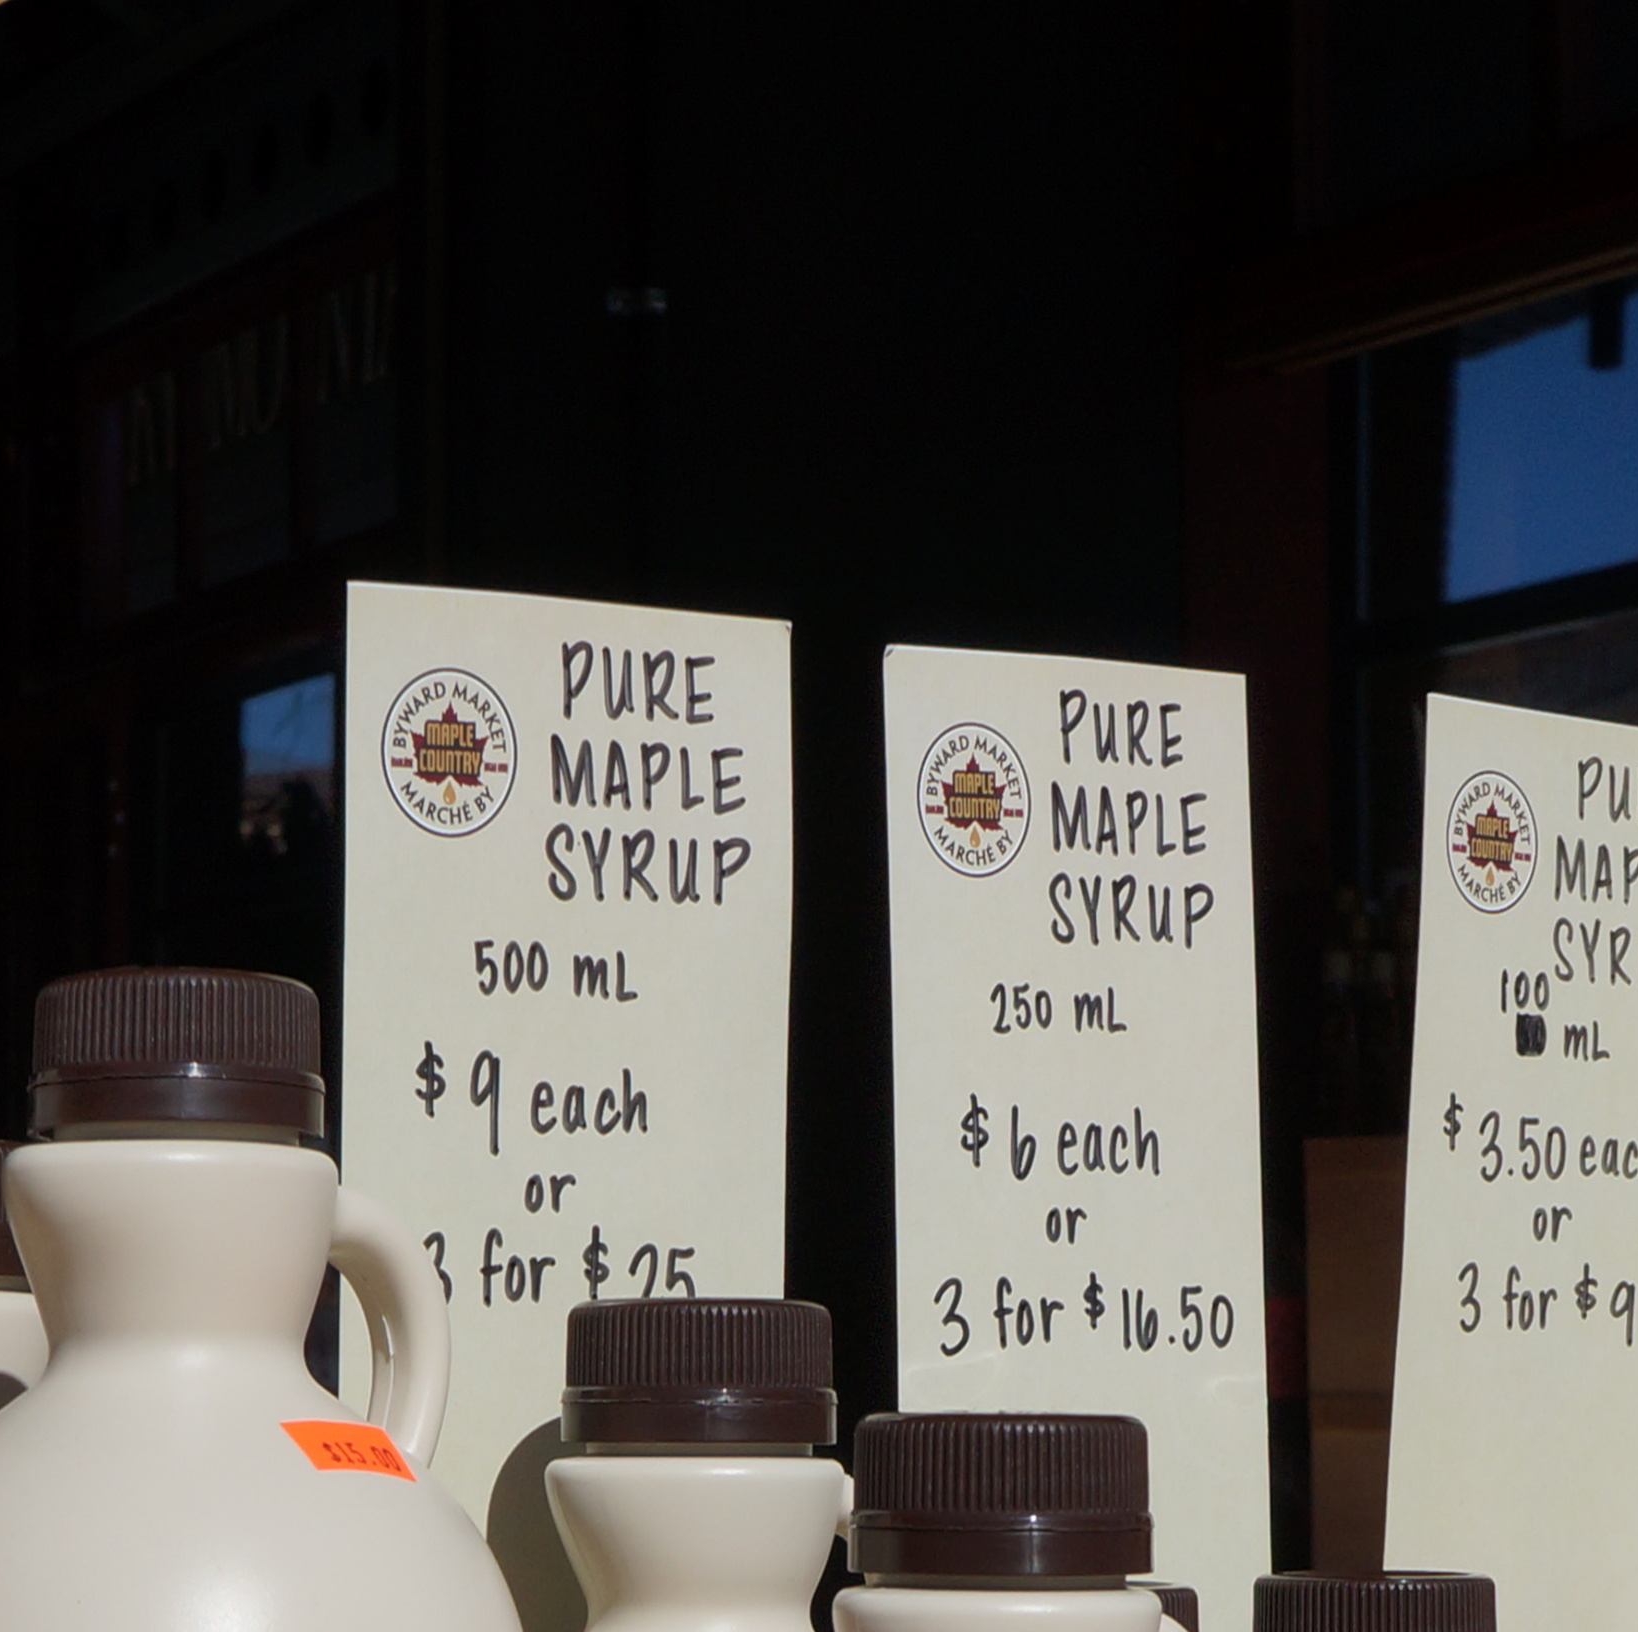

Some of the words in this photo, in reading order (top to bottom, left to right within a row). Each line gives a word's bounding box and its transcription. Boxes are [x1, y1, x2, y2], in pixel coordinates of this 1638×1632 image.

[560, 641, 716, 725] PURE
[393, 681, 445, 749] BYWARD
[452, 681, 506, 753] MARKET
[426, 722, 474, 747] MAPLE
[1058, 687, 1185, 771] PURE
[419, 747, 481, 774] COUNTRY
[550, 733, 747, 814] MAPLE
[926, 735, 969, 796] BYWARD
[974, 735, 1022, 800] MARKET
[954, 773, 995, 795] MAPLE
[400, 781, 473, 825] MARCHÉ
[475, 785, 494, 813] BY
[949, 796, 1001, 819] COUNTRY
[1050, 780, 1209, 857] MAPLE
[1453, 782, 1491, 837] BYWARD
[1494, 783, 1531, 845] MARKET
[1476, 815, 1509, 838] MAPLE
[544, 824, 752, 904] SYRUP
[934, 826, 996, 866] MARCHÉ
[996, 830, 1014, 856] BY
[1471, 838, 1513, 862] COUNTRY
[1048, 872, 1215, 950] SYRUP
[1457, 864, 1506, 903] MARCHÉ
[1506, 871, 1522, 896] BY
[473, 940, 550, 996] 500
[572, 951, 638, 1002] mL
[1500, 969, 1550, 1014] 100
[991, 981, 1053, 1034] 250
[1073, 985, 1128, 1033] mL
[1563, 1020, 1611, 1062] mL
[530, 1068, 649, 1135] each
[1057, 1106, 1161, 1177] each
[524, 1172, 577, 1214] or
[1046, 1205, 1087, 1245] or
[1532, 1205, 1573, 1242] or
[480, 1226, 556, 1307] for
[933, 1276, 971, 1356] 3
[993, 1274, 1064, 1349] for
[1458, 1261, 1483, 1335] 3
[1502, 1265, 1558, 1331] for
